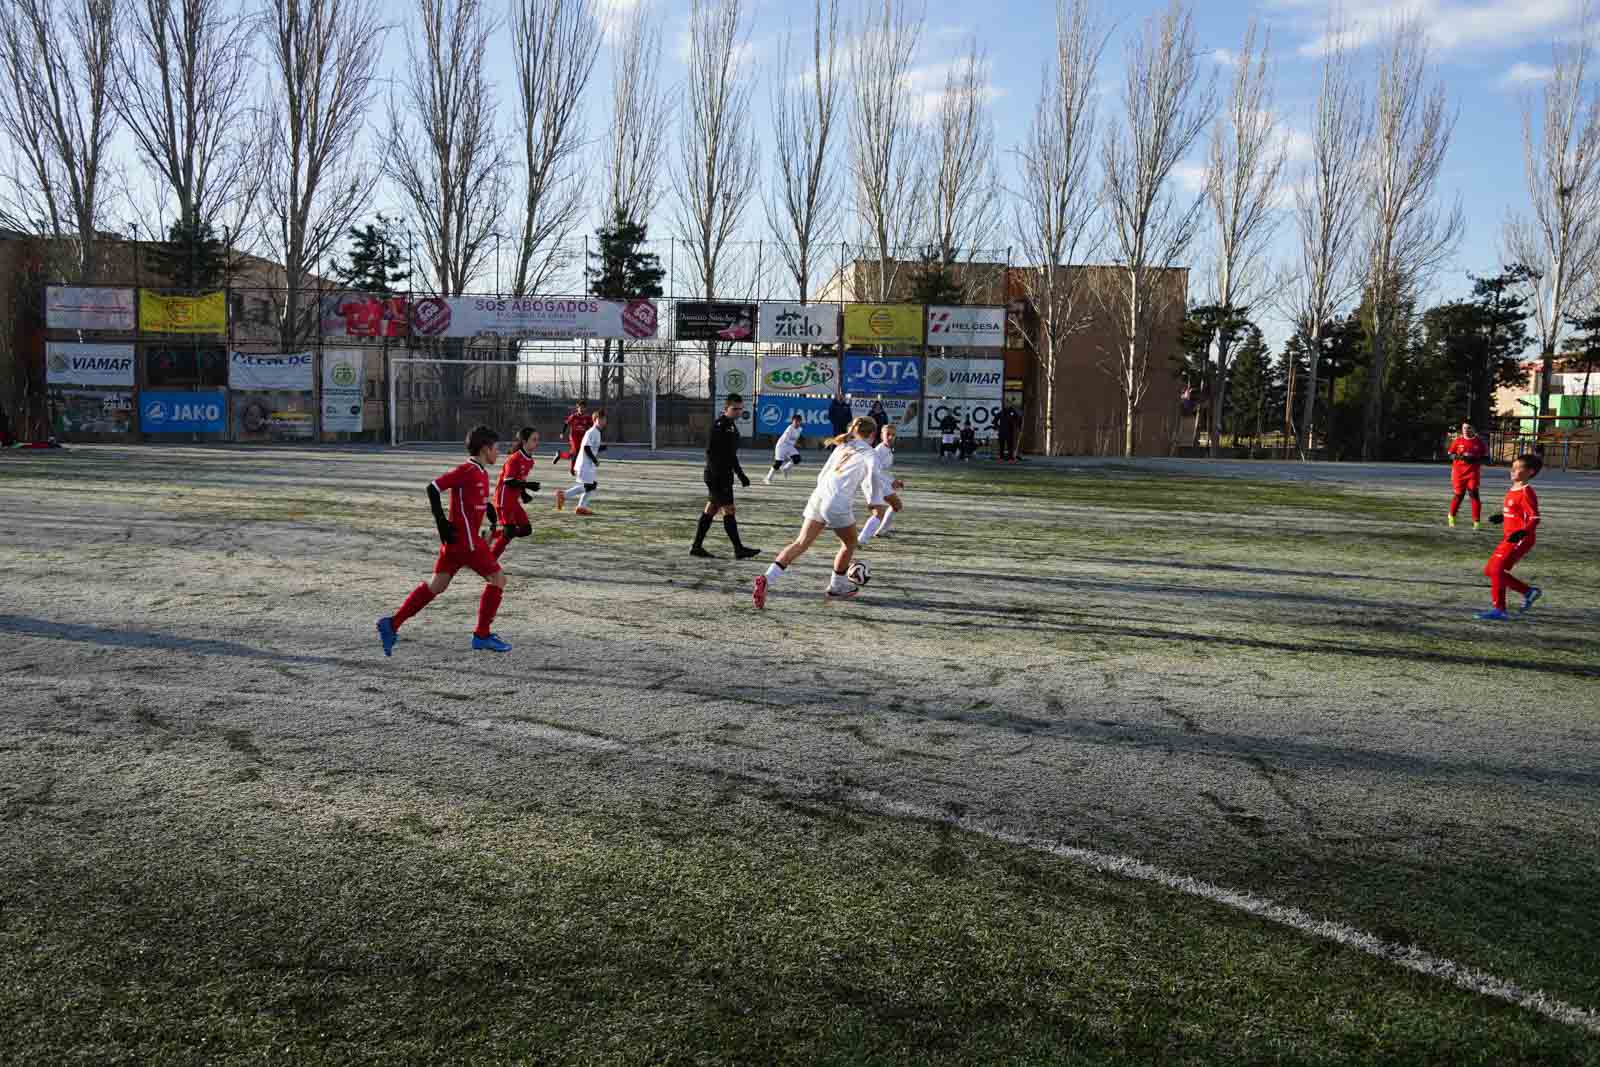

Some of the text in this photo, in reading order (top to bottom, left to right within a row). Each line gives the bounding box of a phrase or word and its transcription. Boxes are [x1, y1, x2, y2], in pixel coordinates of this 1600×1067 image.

[475, 300, 599, 312] SOS ABOGADOS
[72, 357, 132, 371] VIAMAR
[855, 360, 919, 379] JOTA
[950, 371, 1001, 384] VIAMAR
[171, 403, 219, 421] JAKO
